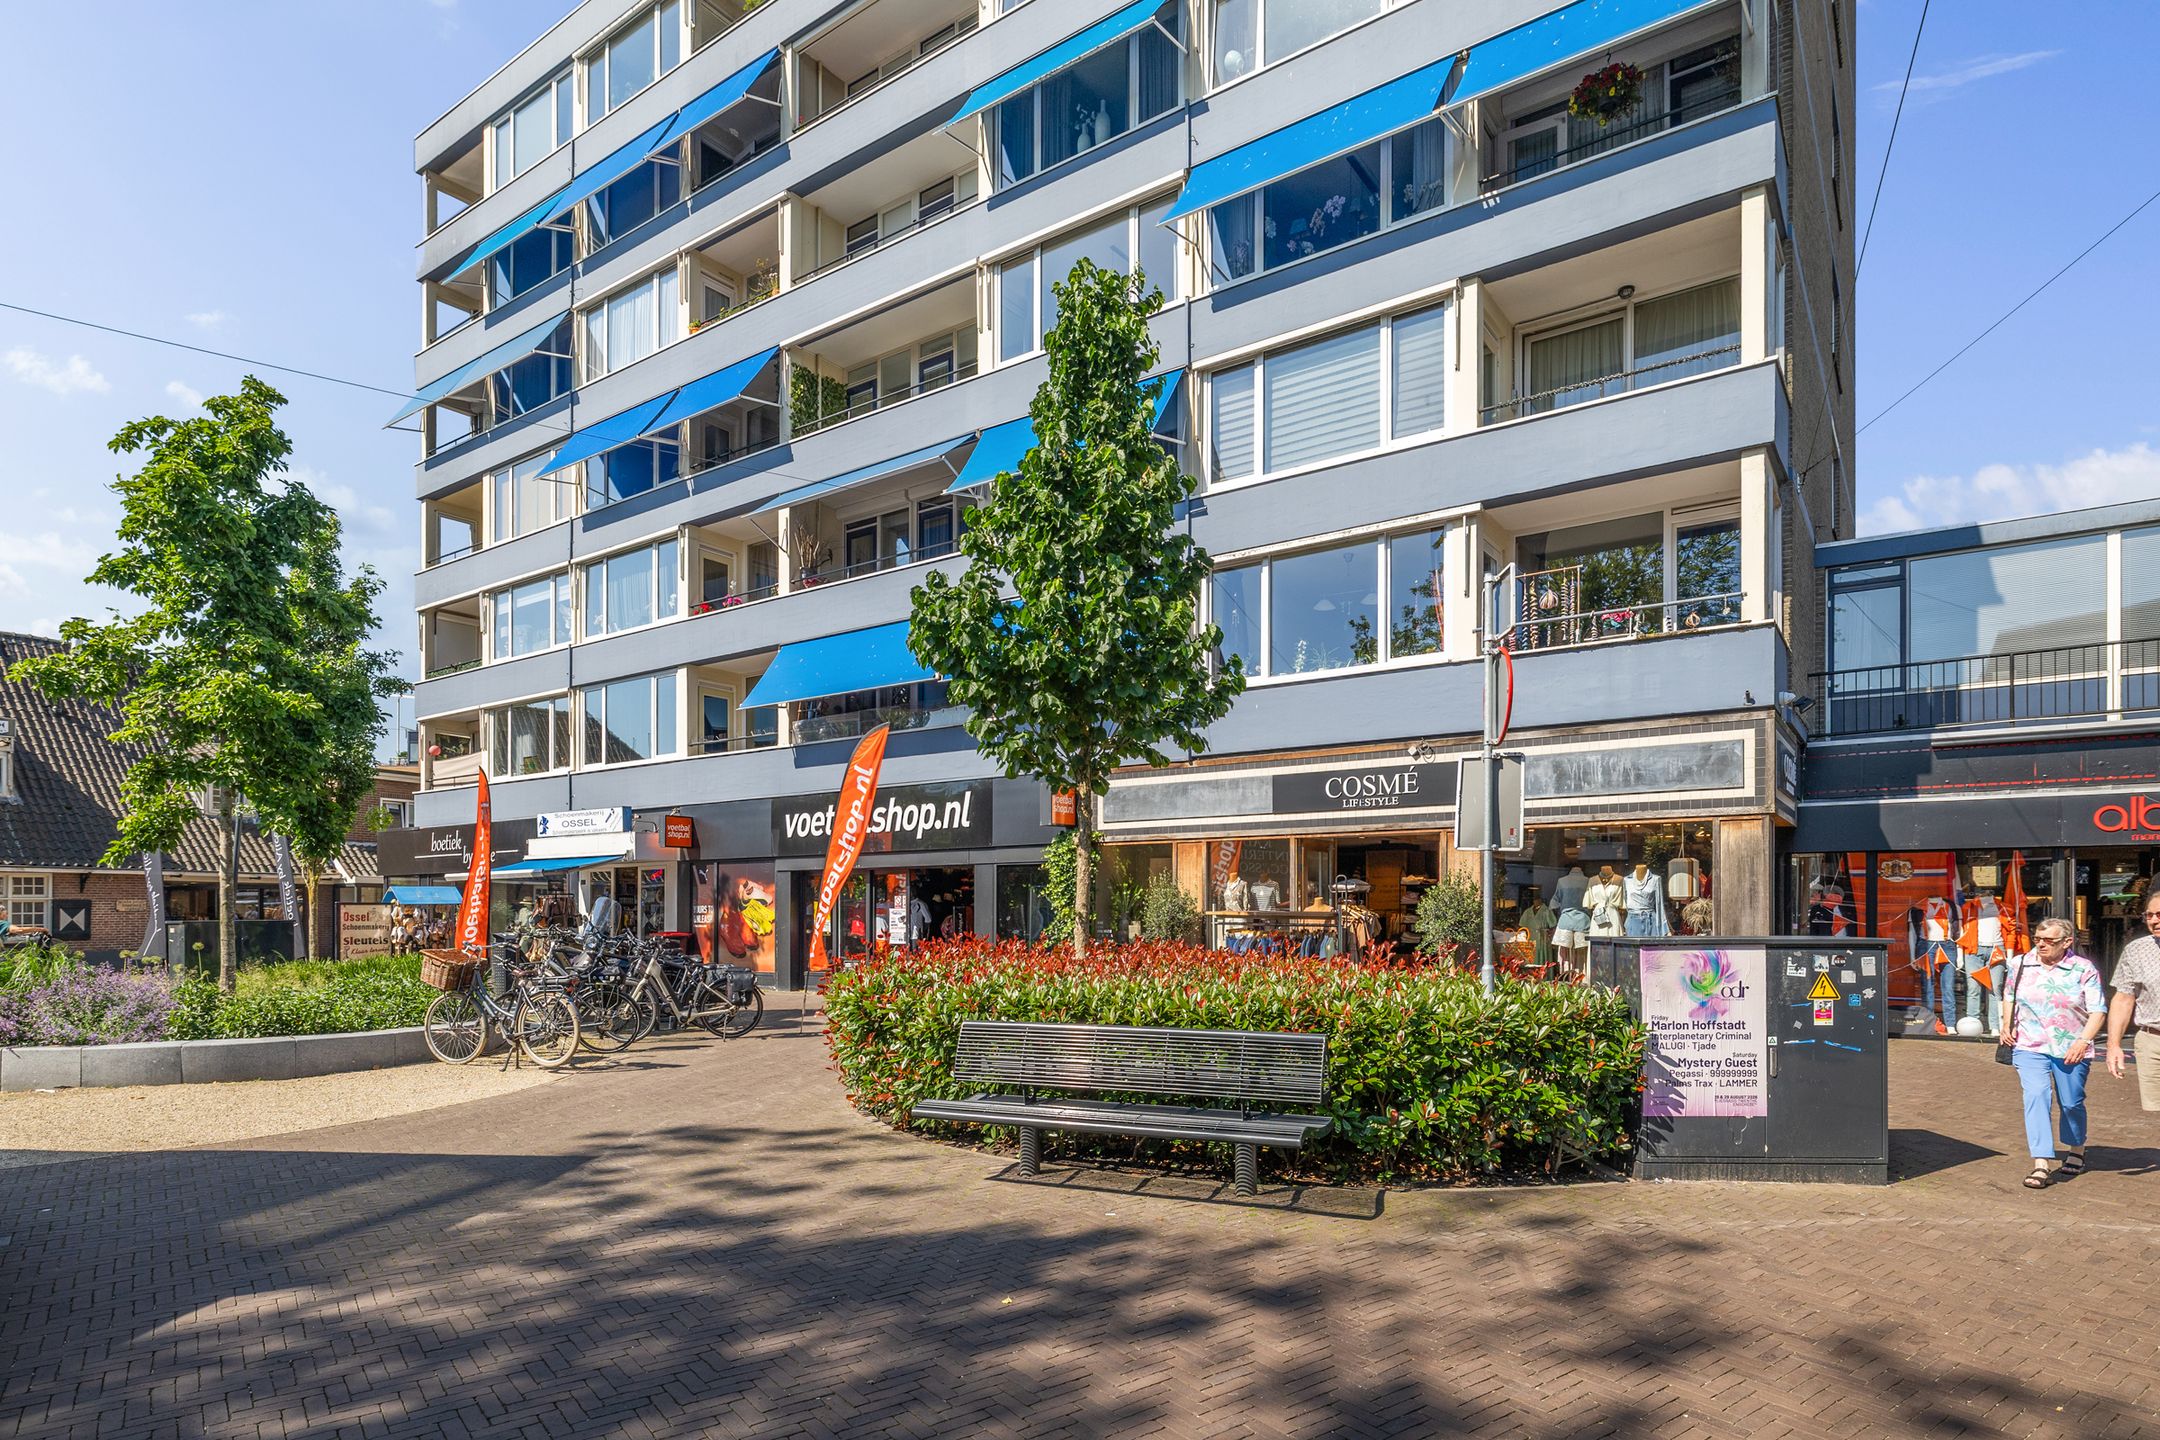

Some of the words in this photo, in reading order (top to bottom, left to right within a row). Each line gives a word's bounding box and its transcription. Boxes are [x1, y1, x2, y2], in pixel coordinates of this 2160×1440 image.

[1325, 766, 1420, 798] COSMÉ
[785, 791, 972, 840] voetshop.nl
[561, 818, 597, 828] OSSEL
[431, 829, 463, 852] boetiek
[810, 764, 873, 958] etbalshop.nl
[343, 912, 370, 922] Ossel
[343, 936, 389, 945] Sleutels
[1651, 1021, 1690, 1031] Marlon
[1692, 1020, 1747, 1031] Hoffstadt
[1651, 1032, 1714, 1042] Interplanetary
[1715, 1032, 1752, 1041] Criminal
[1651, 1042, 1686, 1051] MALUGI
[1692, 1042, 1717, 1052] Tjade
[1677, 1058, 1721, 1069] Mystery
[1725, 1058, 1758, 1068] Guest
[1669, 1069, 1704, 1079] Pegassi
[1710, 1069, 1758, 1078] 999999999
[1666, 1080, 1692, 1088] Palms
[1694, 1080, 1713, 1088] Trax
[1719, 1080, 1758, 1088] LAMMER
